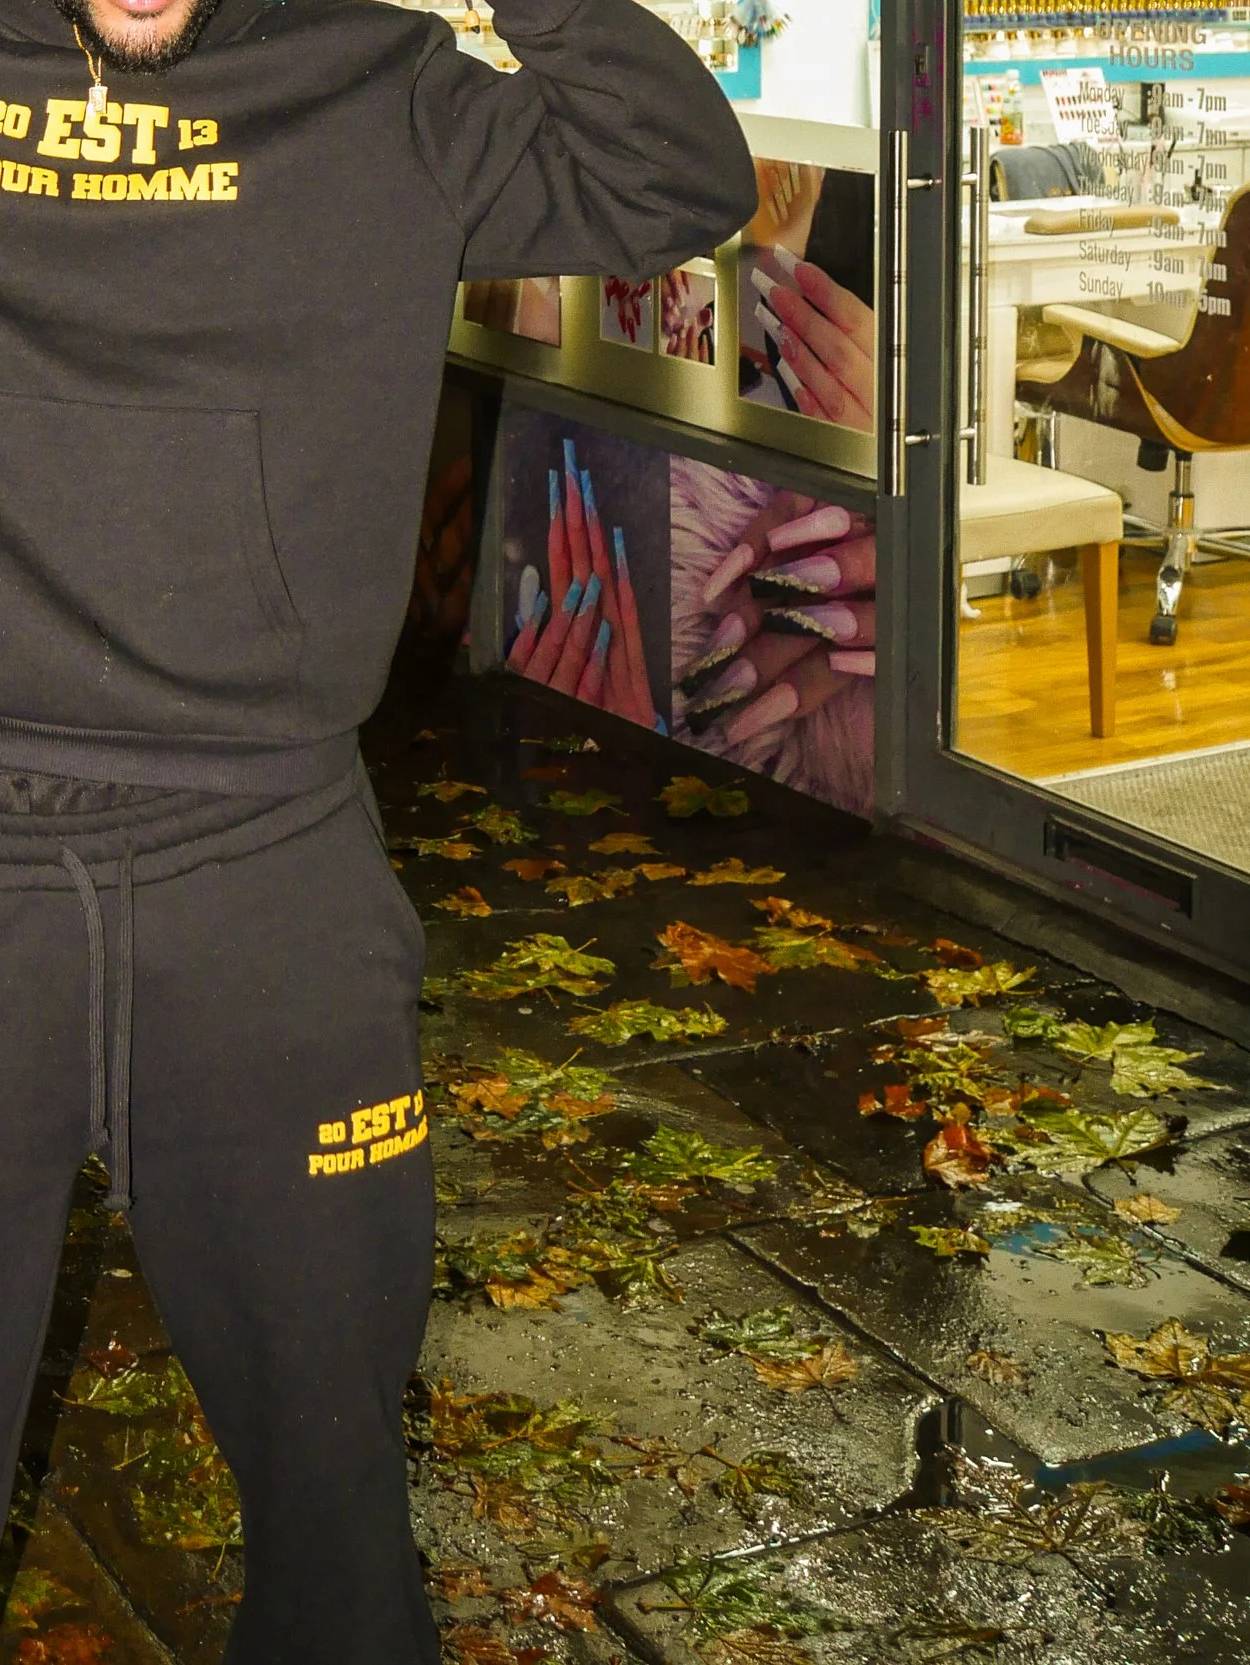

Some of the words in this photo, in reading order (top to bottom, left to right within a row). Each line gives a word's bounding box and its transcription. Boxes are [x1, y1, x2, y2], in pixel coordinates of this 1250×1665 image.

[1096, 18, 1207, 45] OPENING
[1109, 45, 1195, 71] HOURS
[1079, 81, 1125, 110] Monday
[1197, 87, 1227, 112] 7pm
[37, 98, 170, 165] EST
[177, 119, 218, 150] 13
[1197, 121, 1227, 146] 7pm
[71, 162, 239, 201] HOMME
[1197, 154, 1227, 179] 7pm
[1079, 208, 1116, 237] Friday
[1079, 240, 1131, 271] Saturday
[1079, 271, 1123, 303] Sunday
[1199, 288, 1231, 316] 5pm
[318, 1121, 346, 1145] 20
[351, 1094, 411, 1145] EST
[308, 1147, 365, 1176] POUR
